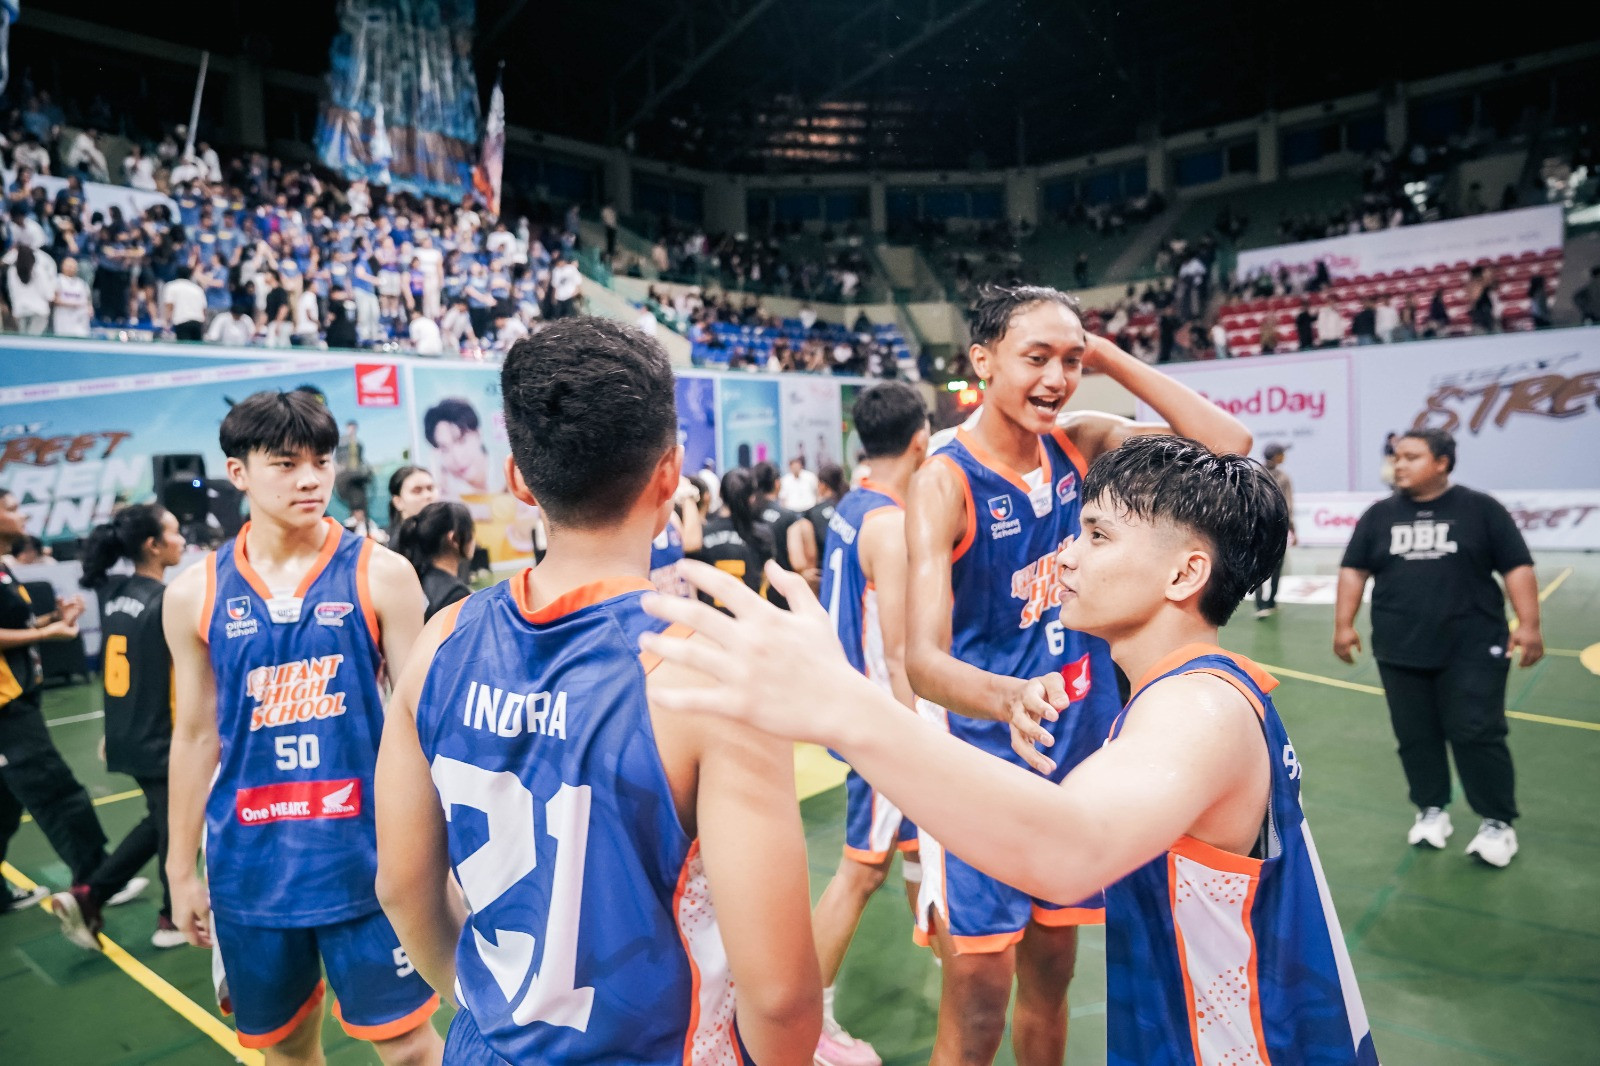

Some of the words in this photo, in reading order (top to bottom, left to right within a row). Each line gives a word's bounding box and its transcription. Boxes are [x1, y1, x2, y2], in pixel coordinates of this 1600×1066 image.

[1267, 385, 1326, 418] Day
[0, 455, 148, 504] REN
[1389, 522, 1458, 555] DBL
[225, 619, 258, 631] Olifant
[226, 626, 259, 639] School
[1045, 619, 1065, 656] 6
[104, 634, 130, 697] 6
[263, 679, 328, 706] HIGH
[463, 681, 568, 740] INDRA
[249, 692, 347, 732] SCHOOL
[275, 734, 320, 770] 50
[241, 807, 269, 822] One
[269, 801, 310, 818] HEART.
[430, 753, 596, 1033] 21
